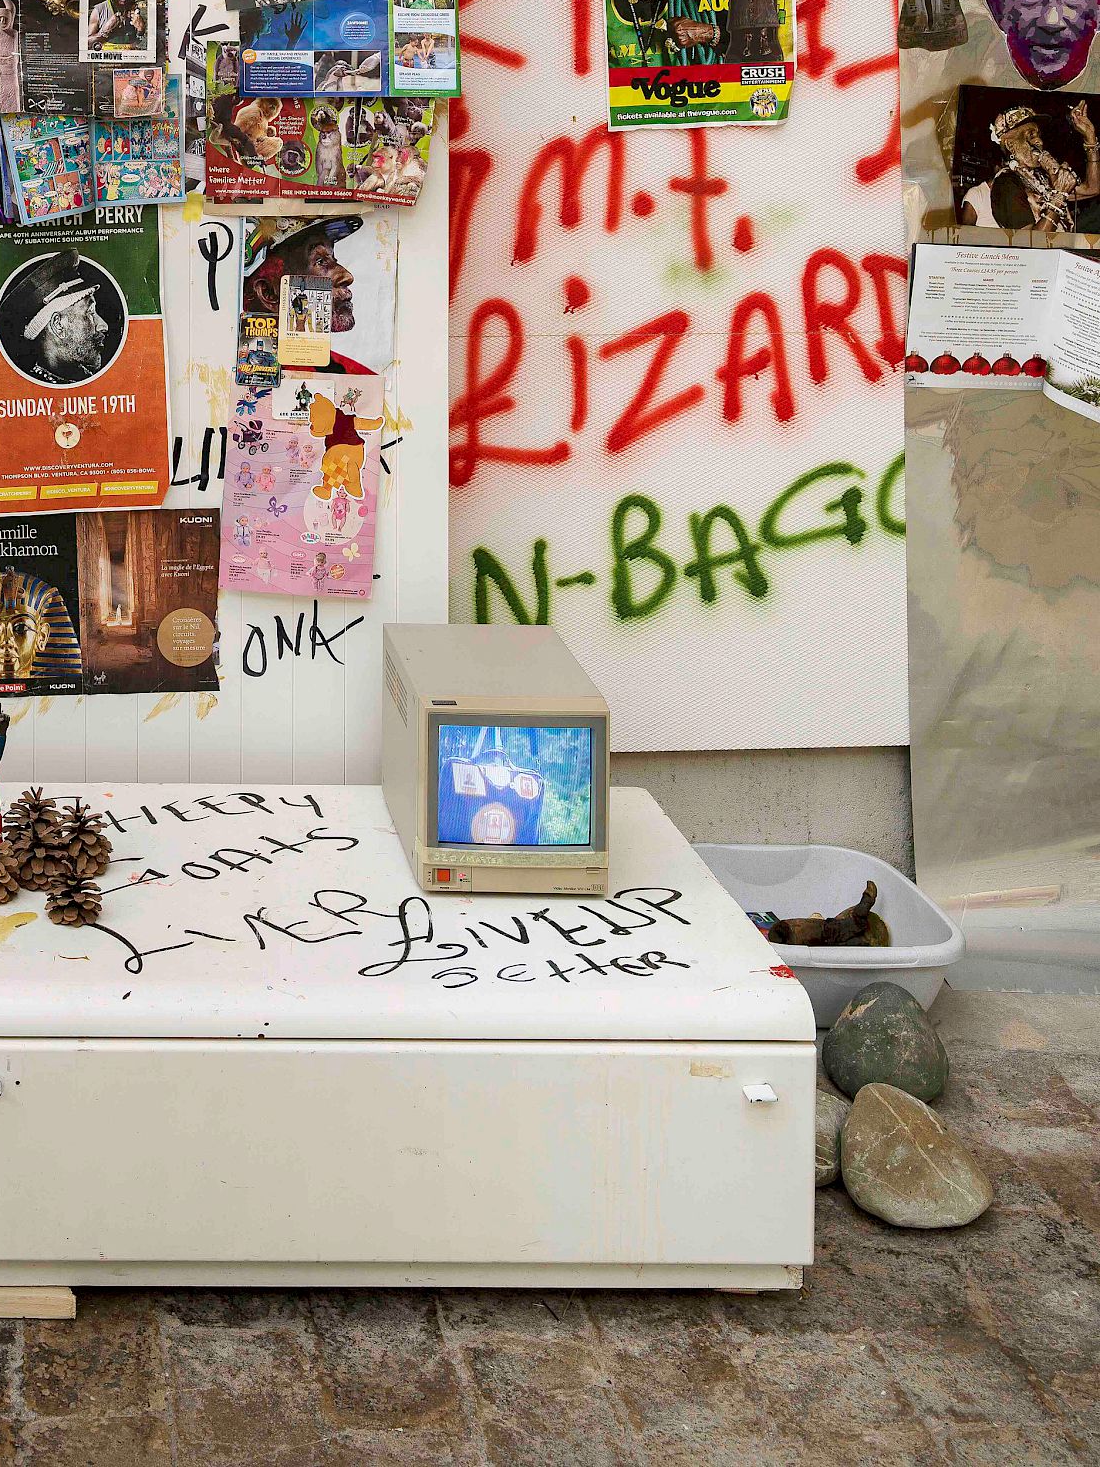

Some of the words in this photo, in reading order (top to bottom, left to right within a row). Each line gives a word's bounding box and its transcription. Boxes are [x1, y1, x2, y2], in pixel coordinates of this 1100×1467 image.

[742, 67, 785, 80] CRUSH
[630, 70, 721, 108] Vogue
[616, 112, 642, 120] tickets
[644, 110, 677, 119] available
[687, 108, 738, 118] thevogue.com
[209, 176, 236, 184] Families
[95, 205, 144, 224] PERRY
[30, 230, 74, 238] ANNIVERSARY
[981, 252, 1000, 260] Lunch
[1001, 253, 1020, 261] Menu
[247, 318, 276, 328] TOP
[245, 327, 278, 337] TRUMPS
[59, 396, 98, 415] JUNE
[101, 394, 136, 414] 19TH
[179, 516, 213, 524] KUONI
[5, 684, 24, 692] Point
